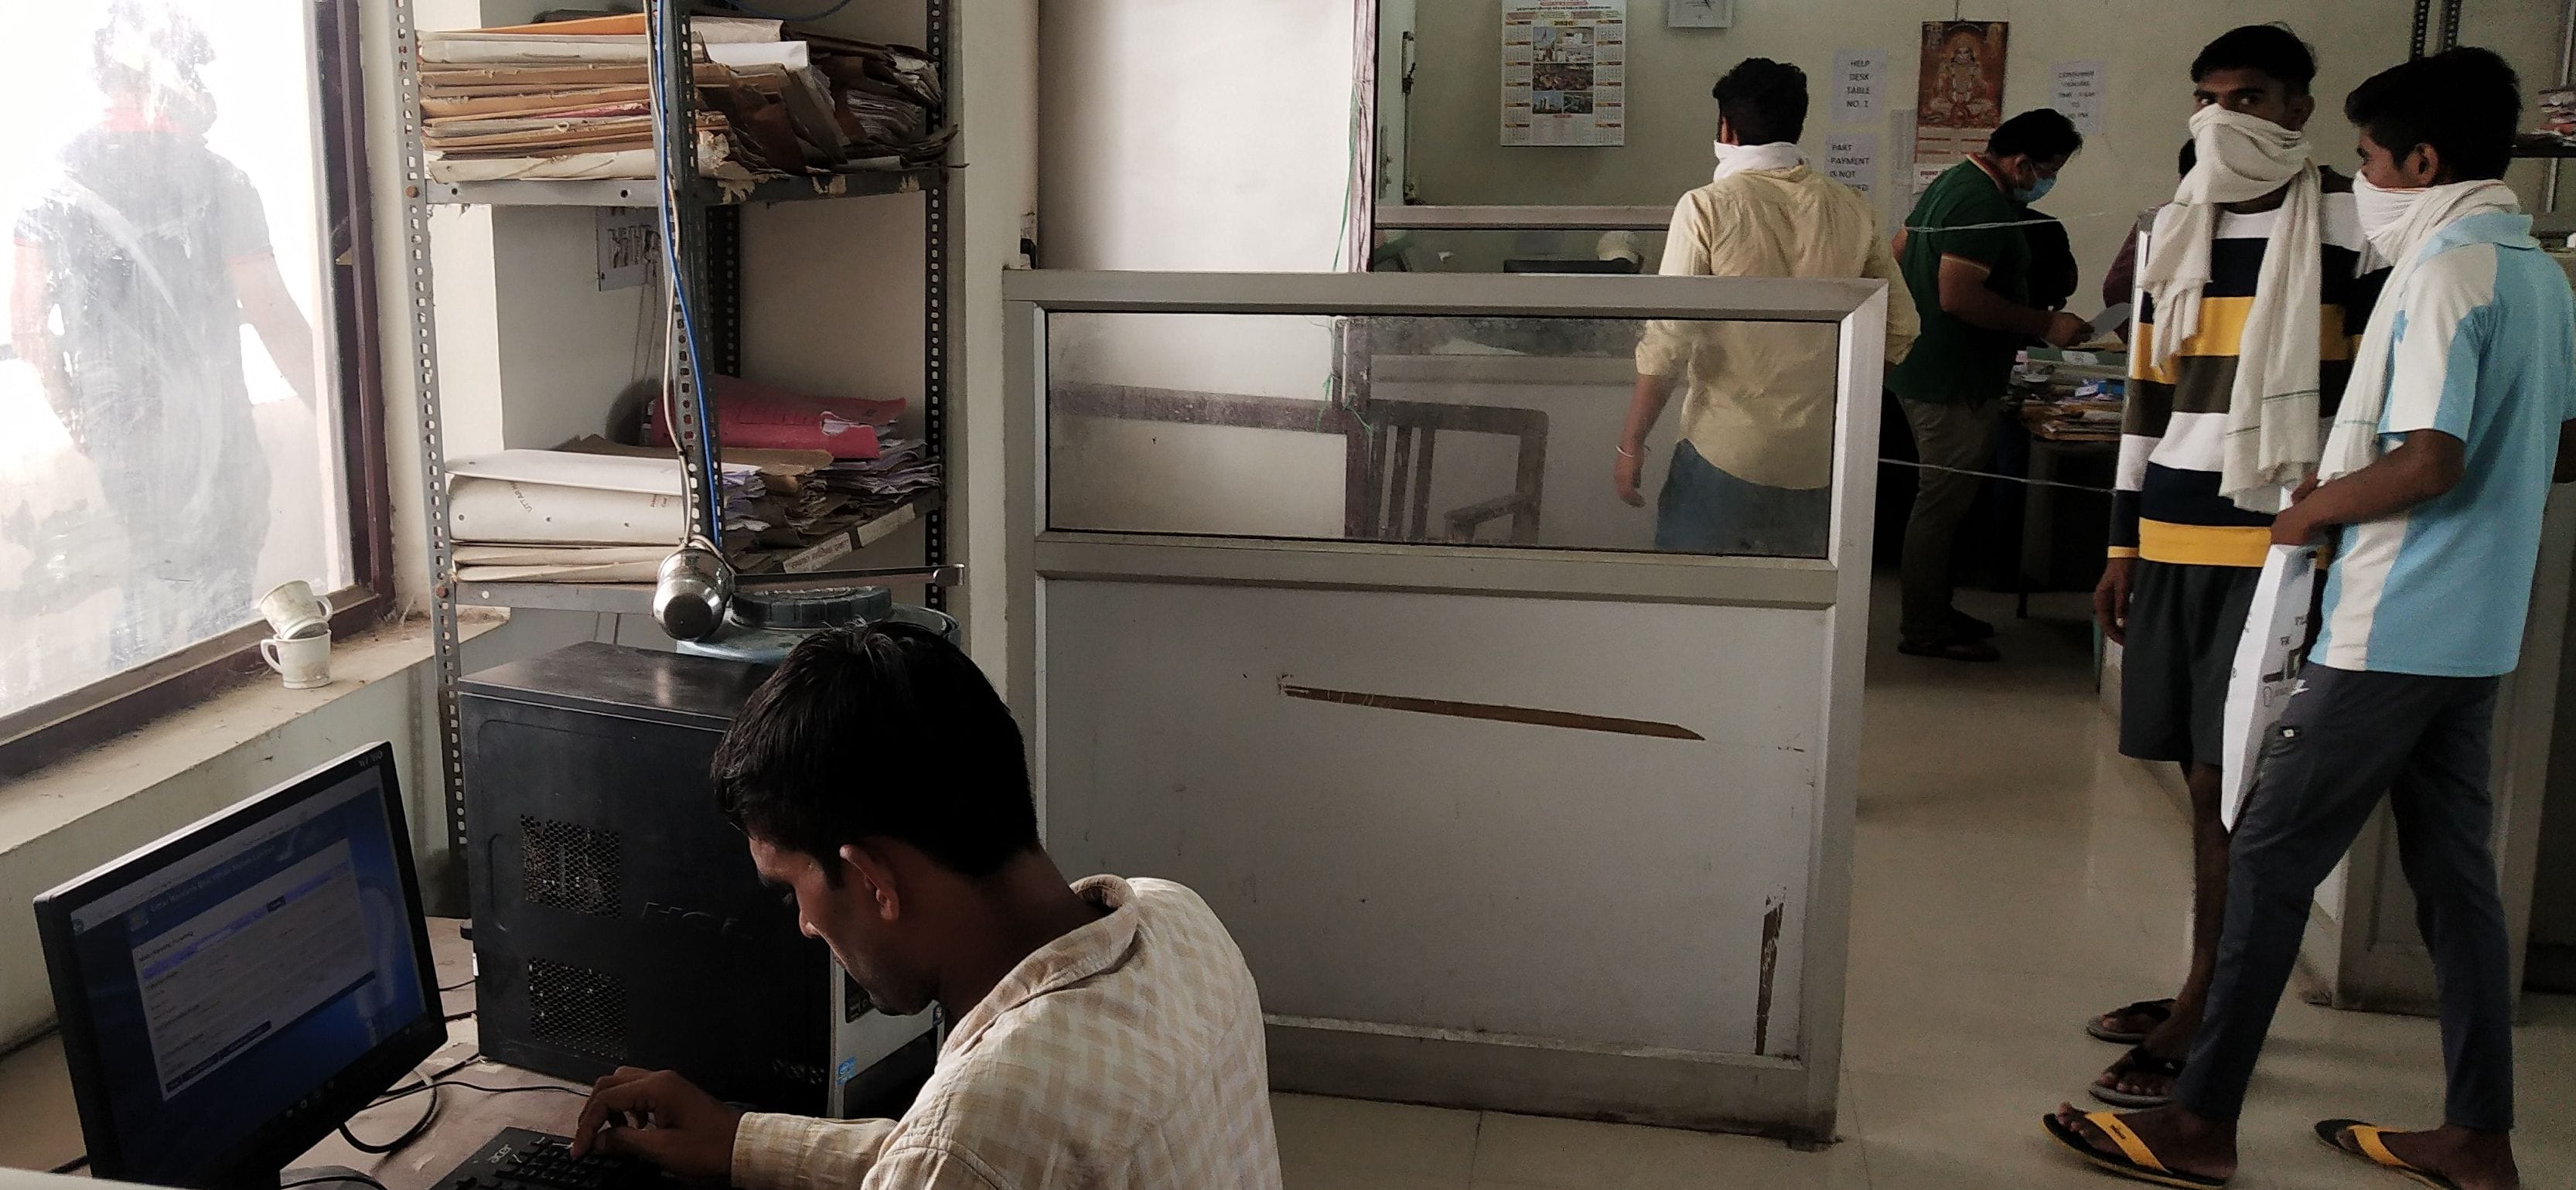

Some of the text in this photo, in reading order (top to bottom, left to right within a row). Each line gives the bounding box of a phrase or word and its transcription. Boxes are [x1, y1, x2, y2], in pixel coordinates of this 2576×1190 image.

[1850, 60, 1871, 68] HELP
[1846, 86, 1871, 94] TABLE
[1830, 156, 1870, 165] PAYMENT
[487, 1143, 513, 1164] acer
